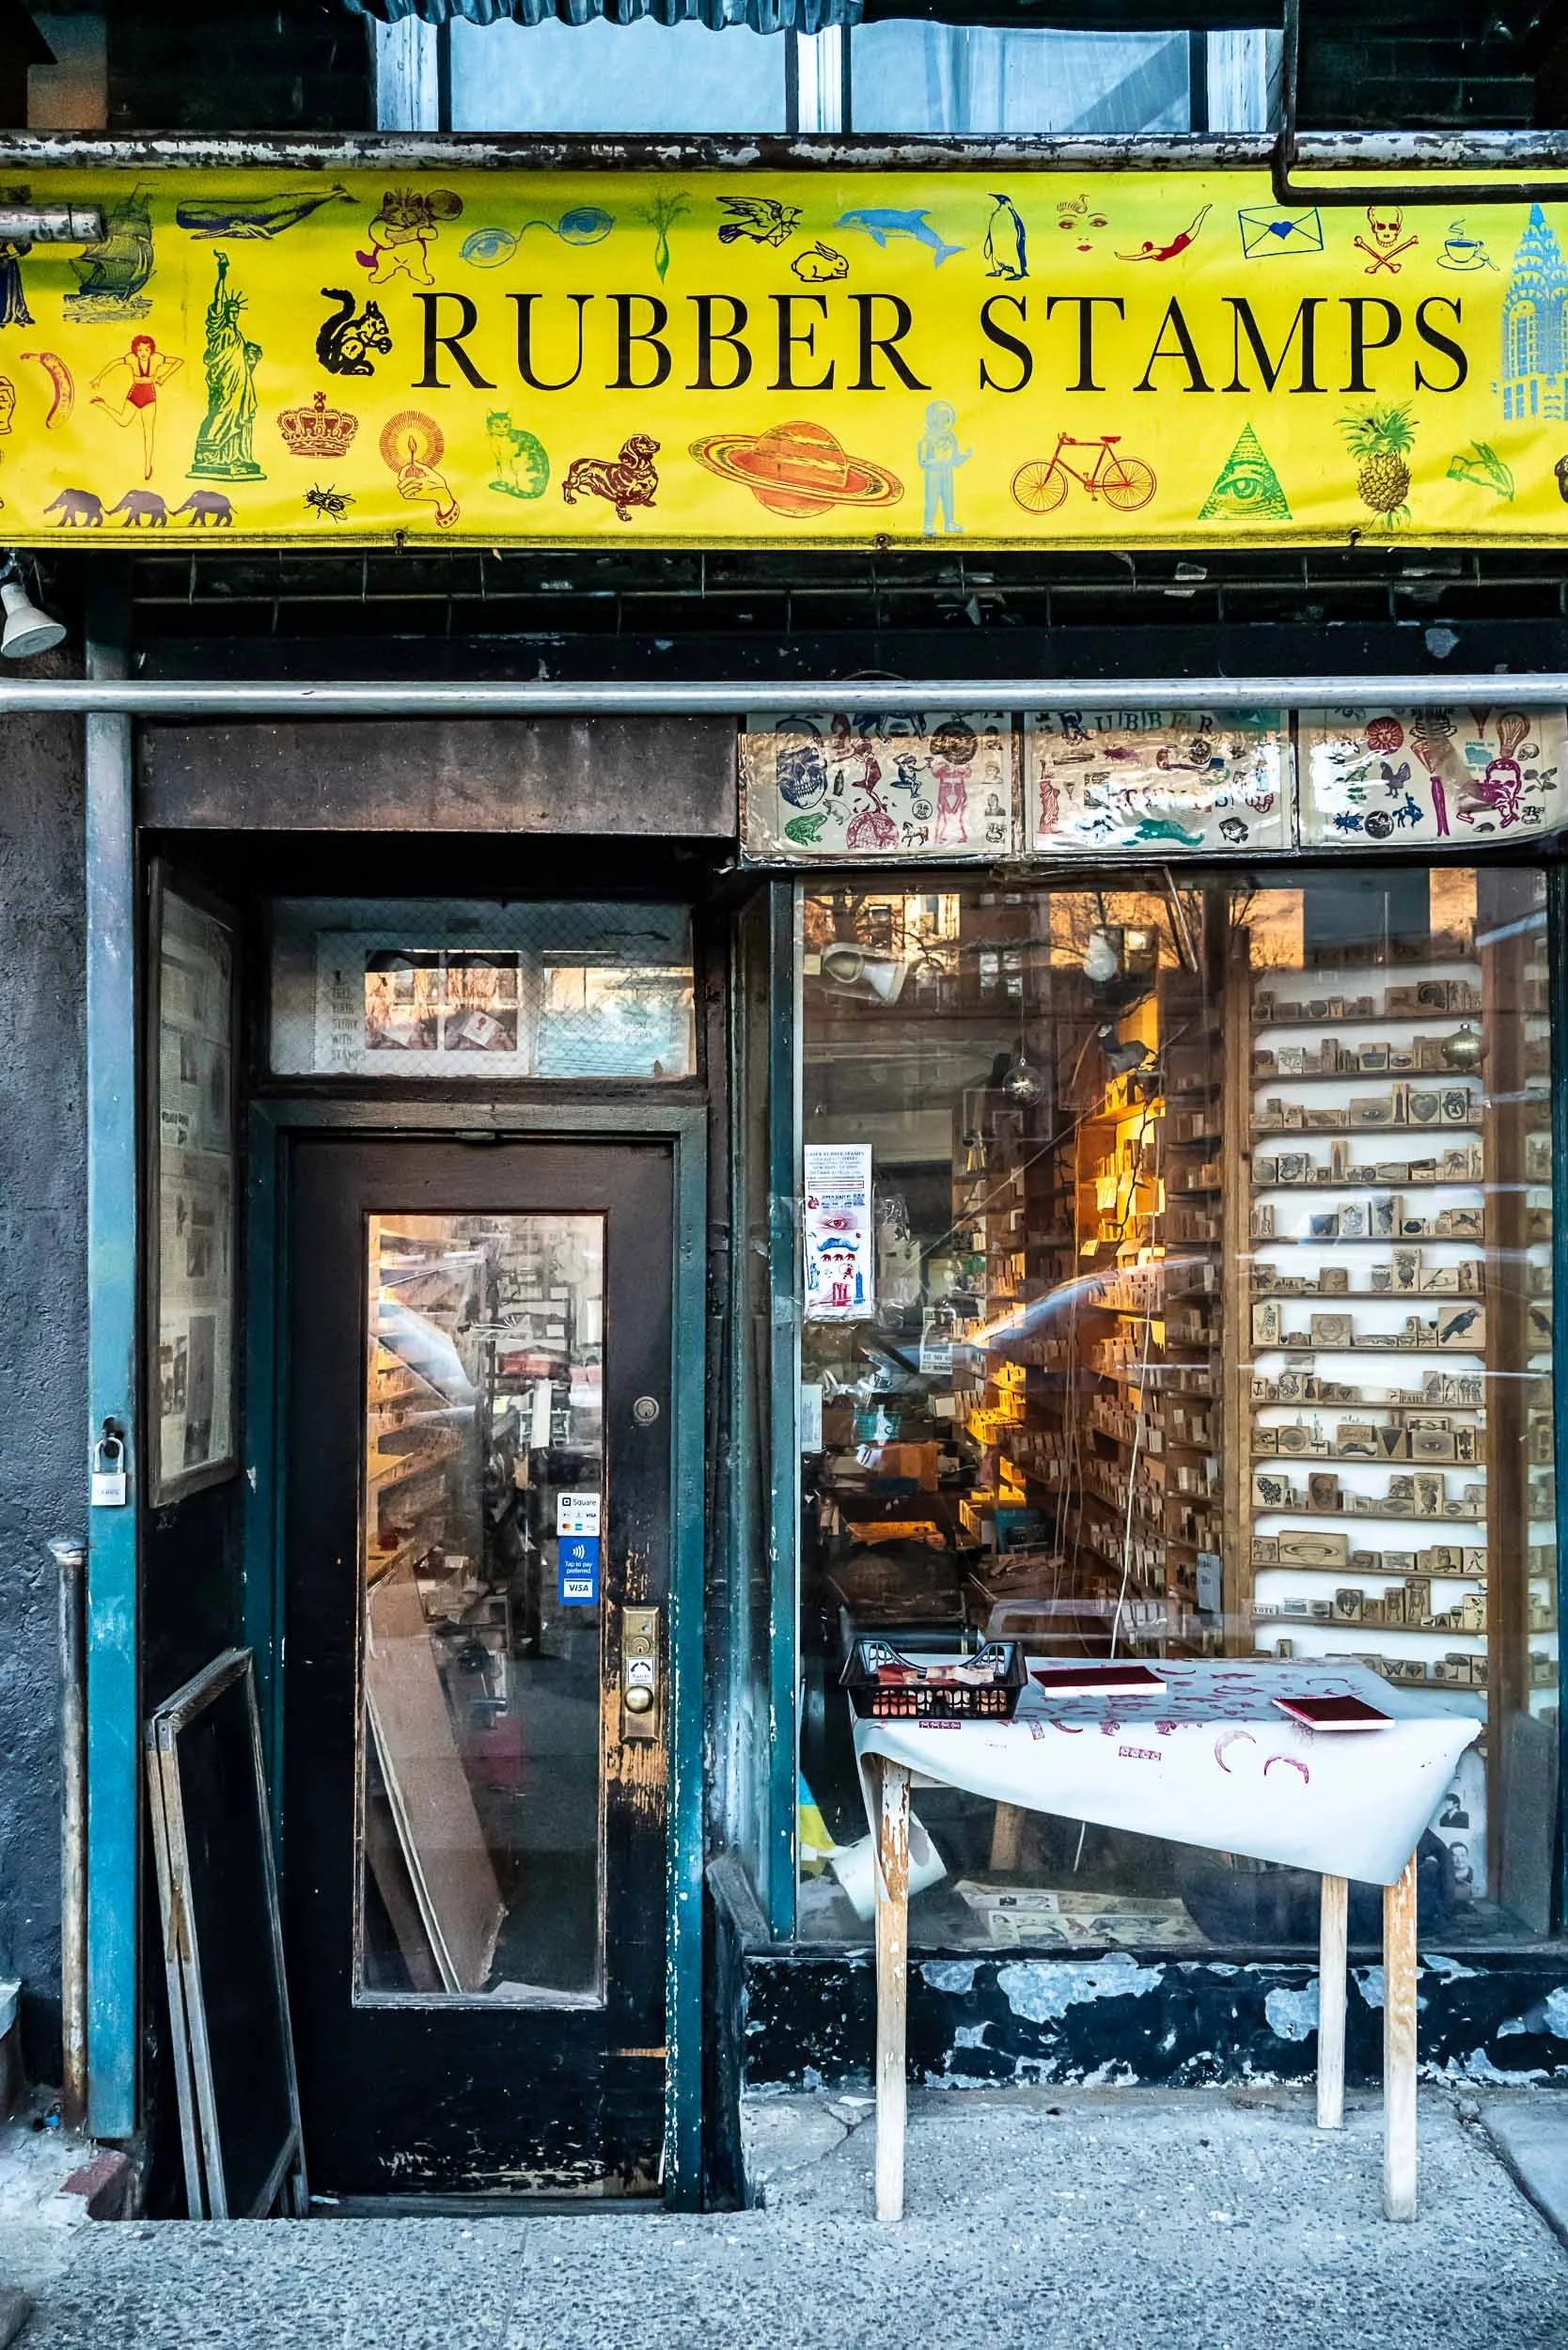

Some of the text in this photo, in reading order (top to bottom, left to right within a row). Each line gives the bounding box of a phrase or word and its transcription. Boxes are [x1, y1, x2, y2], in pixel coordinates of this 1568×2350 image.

[411, 292, 1468, 393] RUBBER STAMPS
[1059, 711, 1214, 740] RUBBER
[572, 1498, 597, 1507] Square
